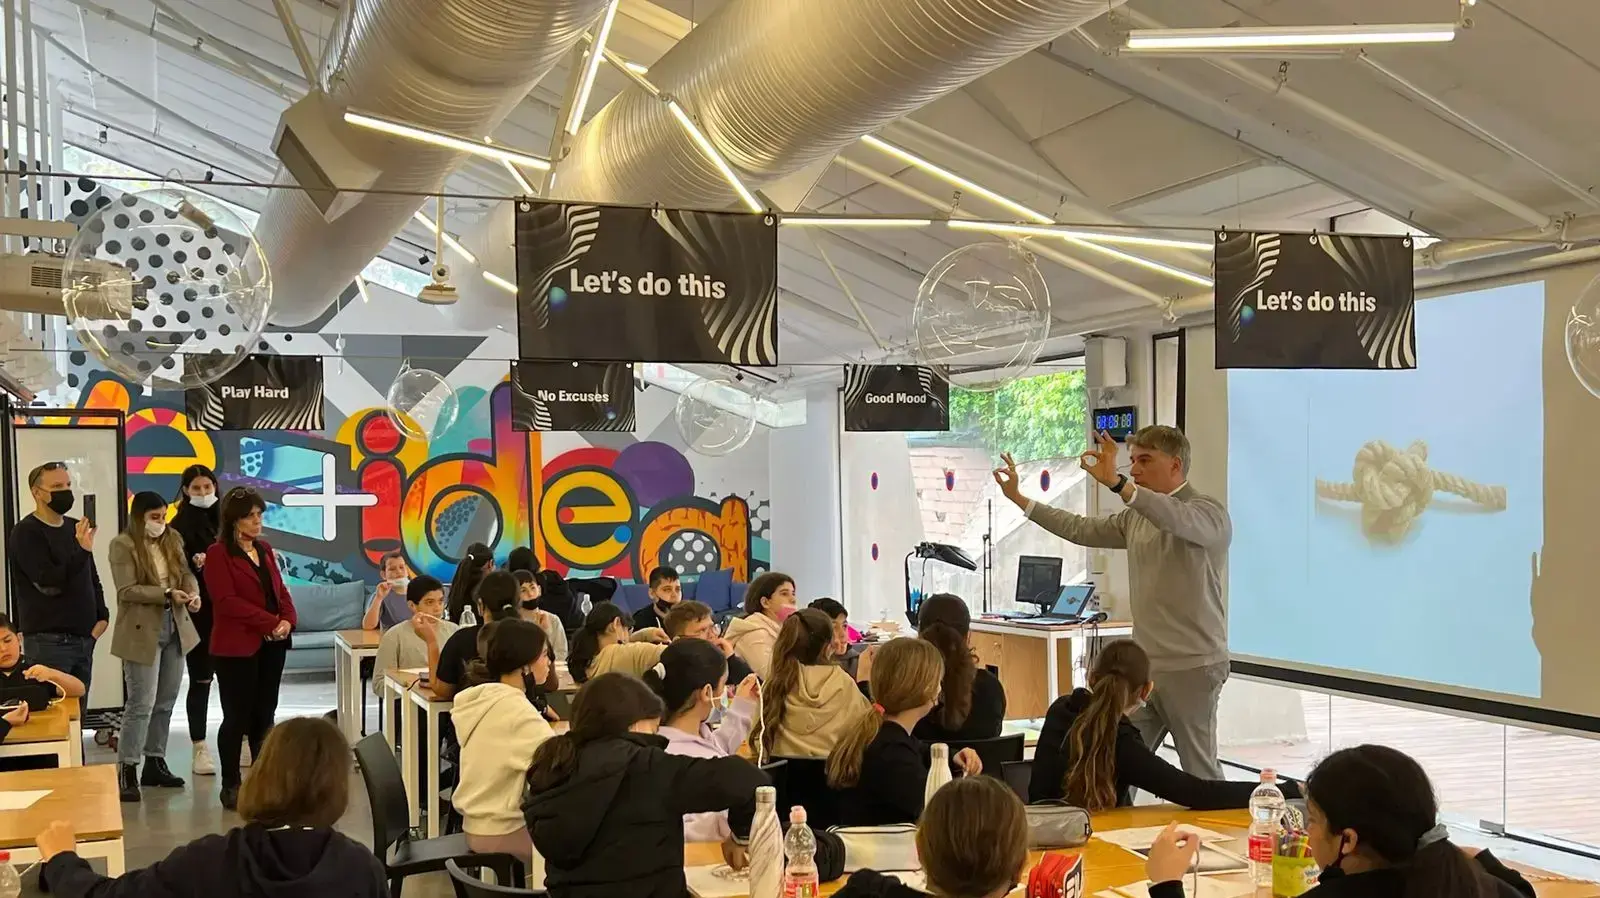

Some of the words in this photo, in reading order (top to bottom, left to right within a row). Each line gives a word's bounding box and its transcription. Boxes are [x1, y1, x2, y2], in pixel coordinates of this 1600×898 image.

[570, 267, 633, 295] Let's
[637, 271, 672, 296] do
[677, 273, 727, 299] this
[1256, 289, 1304, 311] Let's
[1306, 290, 1335, 312] do
[1338, 291, 1377, 312] this
[221, 385, 252, 399] Play
[254, 385, 289, 399] Hard
[537, 389, 557, 402] No
[558, 389, 610, 403] Excuses
[864, 392, 894, 404] Good
[896, 392, 927, 404] Mood
